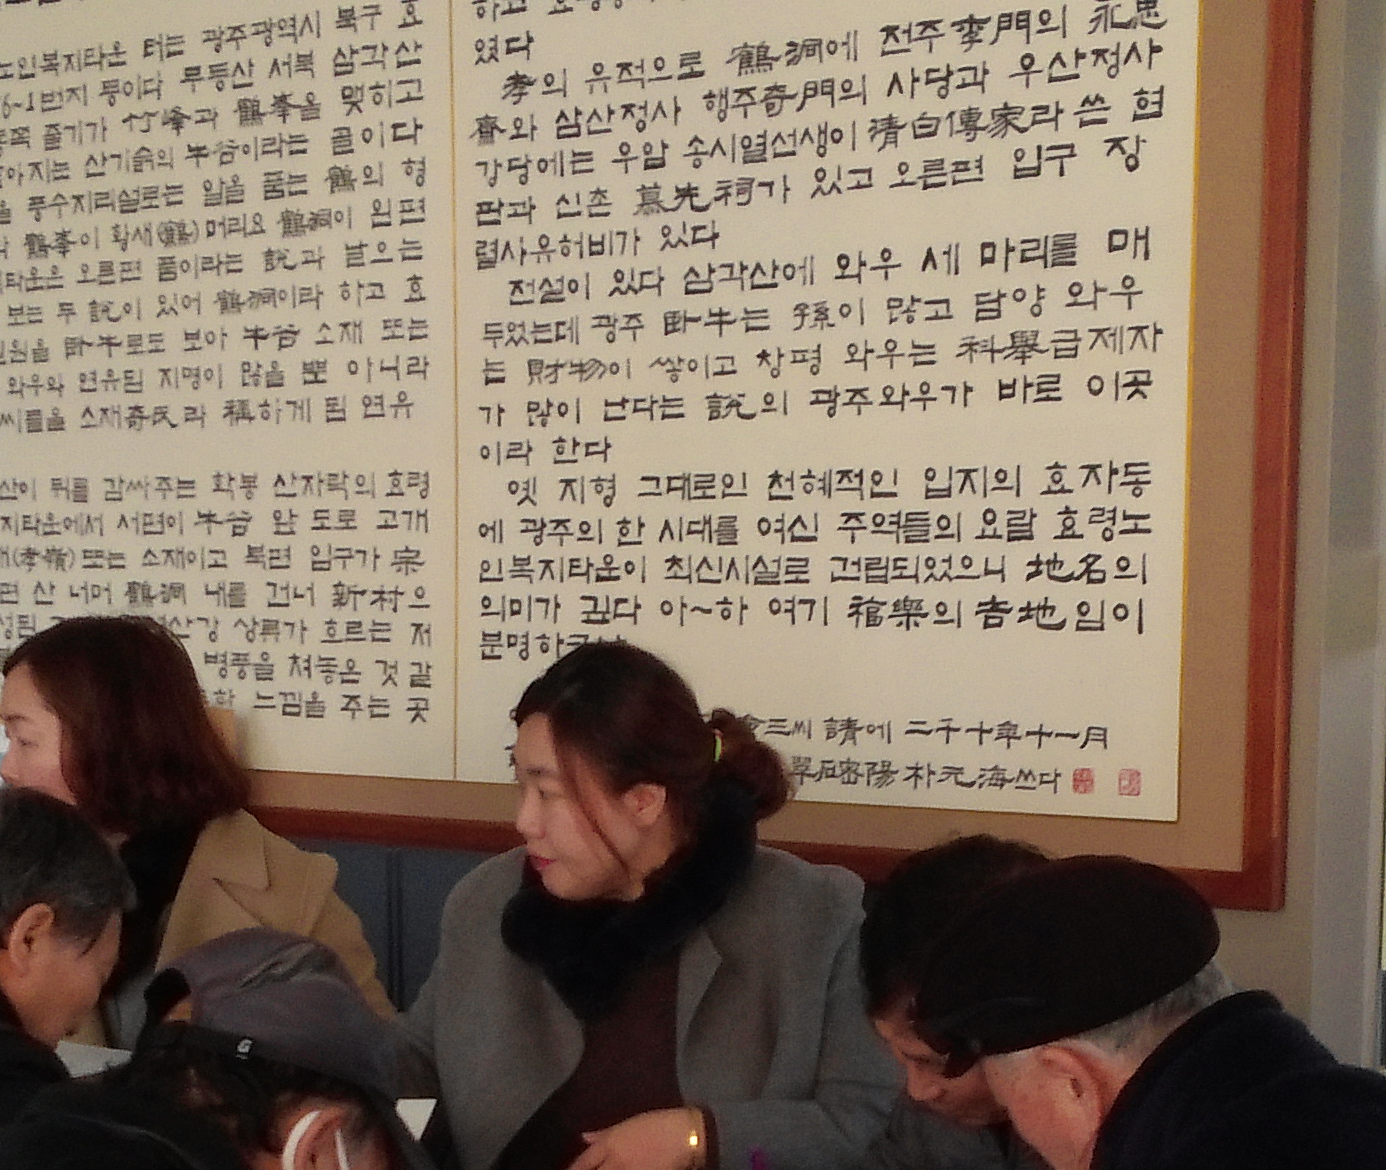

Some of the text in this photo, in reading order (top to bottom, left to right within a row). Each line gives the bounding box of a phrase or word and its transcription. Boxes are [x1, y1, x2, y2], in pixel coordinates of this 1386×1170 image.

[202, 10, 320, 53] 광주광역시
[335, 4, 382, 32] 북구
[475, 30, 534, 65] 였다
[180, 41, 422, 92] 무등산 서북 삼각산
[585, 51, 705, 94] 유적으로
[555, 38, 1164, 140] 삼산정사 사당과 우산정사
[475, 150, 594, 188] 강당에는
[611, 139, 669, 174] 우암
[1132, 85, 1164, 122] 현
[556, 187, 612, 219] 신촌
[811, 165, 873, 199] 있고
[889, 155, 984, 190] 오른편
[1013, 143, 1068, 180] 입구
[1103, 134, 1147, 172] 장
[660, 220, 720, 251] 있다
[509, 272, 590, 306] 전설이
[608, 266, 665, 297] 있다
[684, 255, 814, 295] 삼각산에
[834, 247, 901, 284] 와우
[980, 233, 1077, 273] 마리를
[1108, 226, 1150, 261] 매
[339, 281, 385, 307] 하고
[483, 275, 1143, 349] 두었는데 광주 많고 담양 와우
[348, 355, 429, 383] 아니라
[756, 343, 821, 379] 창평
[844, 338, 937, 372] 와우는
[527, 398, 580, 427] 많이
[998, 373, 1062, 404] 바로
[1087, 369, 1153, 401] 이곳
[480, 436, 612, 466] 이라 한다
[559, 473, 616, 508] 지형
[637, 472, 747, 501] 그대로인
[767, 468, 898, 501] 천혜적인
[924, 465, 1020, 500] 입지의
[1040, 460, 1151, 498] 효자동
[311, 509, 357, 530] 도로
[376, 509, 428, 533] 고개
[478, 505, 1152, 547] 에 광주의 한 시대를 여신 주역들의 요람 효령노
[311, 544, 380, 572] 입구가
[479, 554, 645, 584] 인복지타운이
[664, 555, 810, 585] 최신시설로
[830, 554, 1005, 584] 건립되었으니
[481, 594, 561, 624] 의미가
[580, 595, 641, 625] 깊다
[768, 595, 828, 626] 여기
[320, 619, 391, 643] 흐르는
[340, 695, 390, 719] 주는
